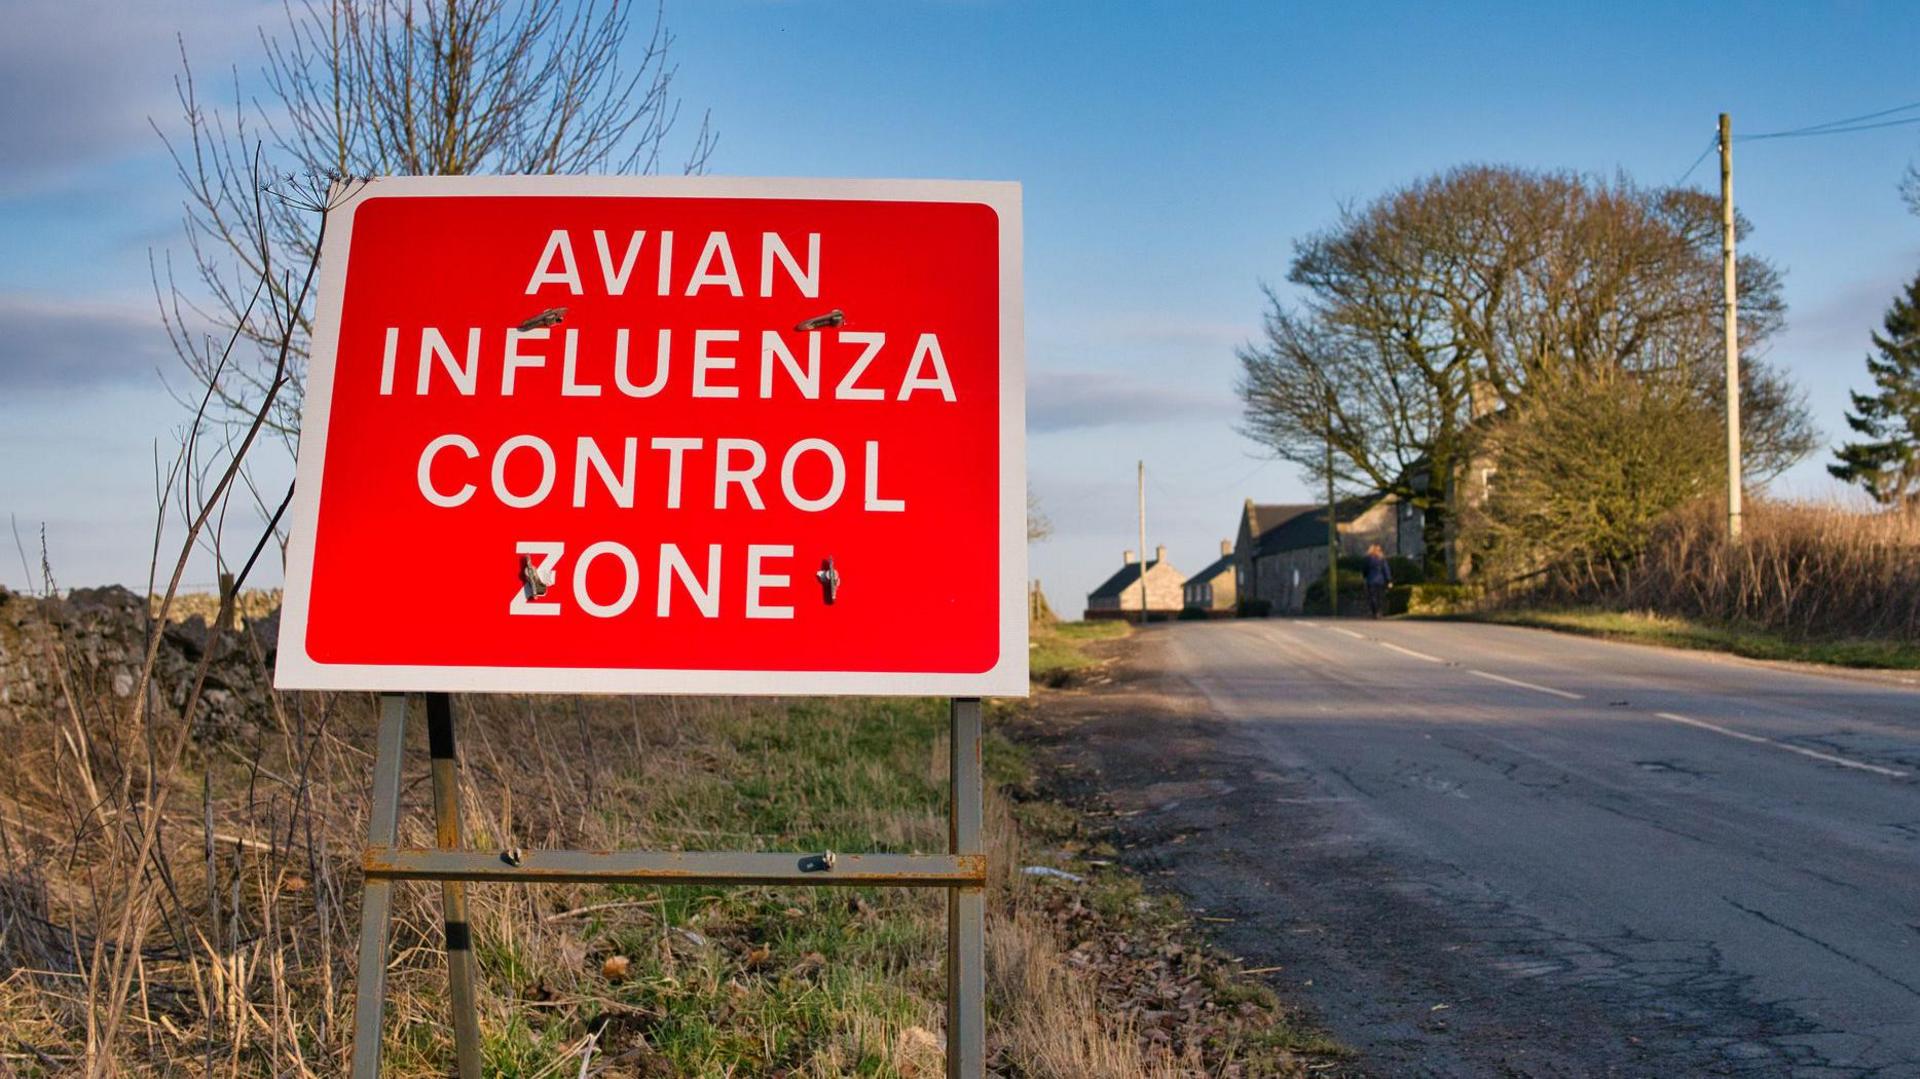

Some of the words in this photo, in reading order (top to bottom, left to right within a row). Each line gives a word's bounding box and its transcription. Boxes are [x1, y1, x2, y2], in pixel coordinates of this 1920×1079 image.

[524, 229, 822, 299] AVIAN
[379, 326, 958, 403] INFLUENZA
[416, 433, 907, 513] CONTROL
[508, 540, 796, 620] ZONE
